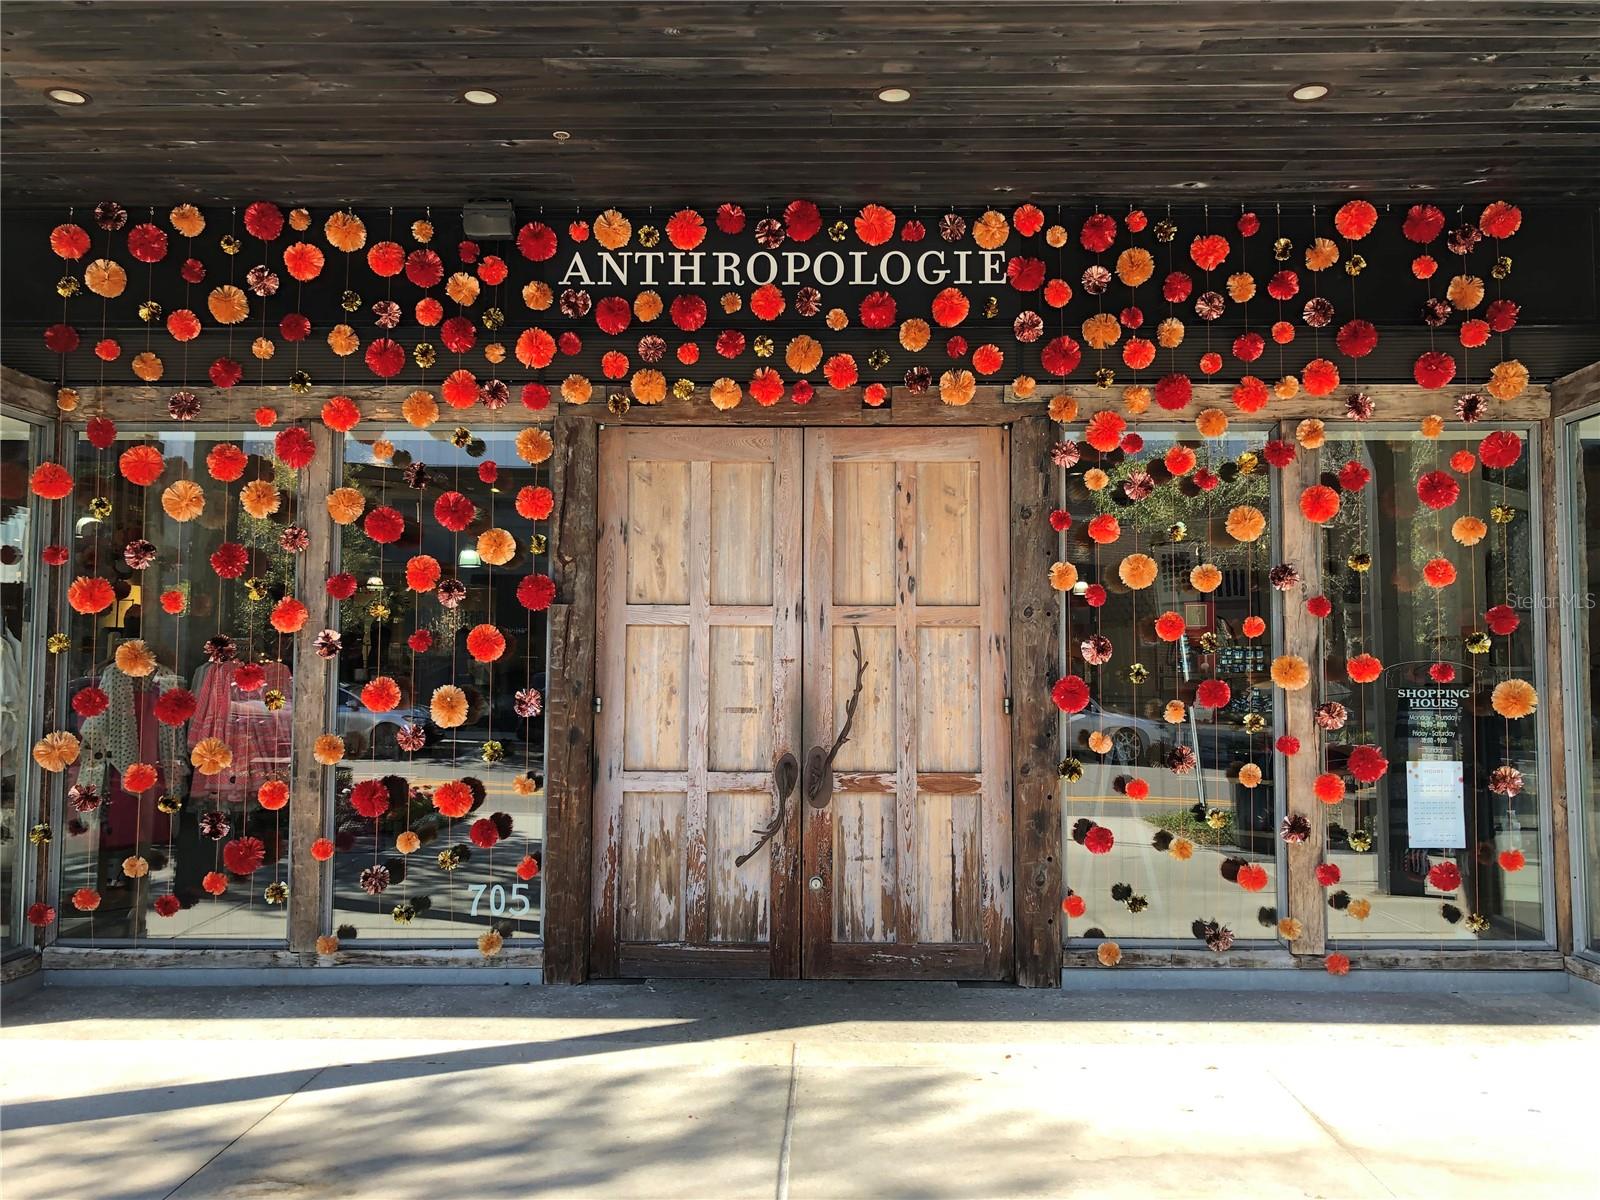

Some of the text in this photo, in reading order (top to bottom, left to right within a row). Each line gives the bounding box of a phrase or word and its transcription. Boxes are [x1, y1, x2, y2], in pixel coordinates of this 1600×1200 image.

[557, 250, 1007, 286] ANTHROPOLOGIE
[1397, 689, 1470, 698] SHOPPING
[1409, 698, 1459, 708] HOURS
[1408, 714, 1431, 722] Monday
[1435, 714, 1457, 722] Thursday
[1412, 730, 1428, 738] Friday
[1431, 730, 1456, 738] Saturday
[468, 884, 530, 917] 705
